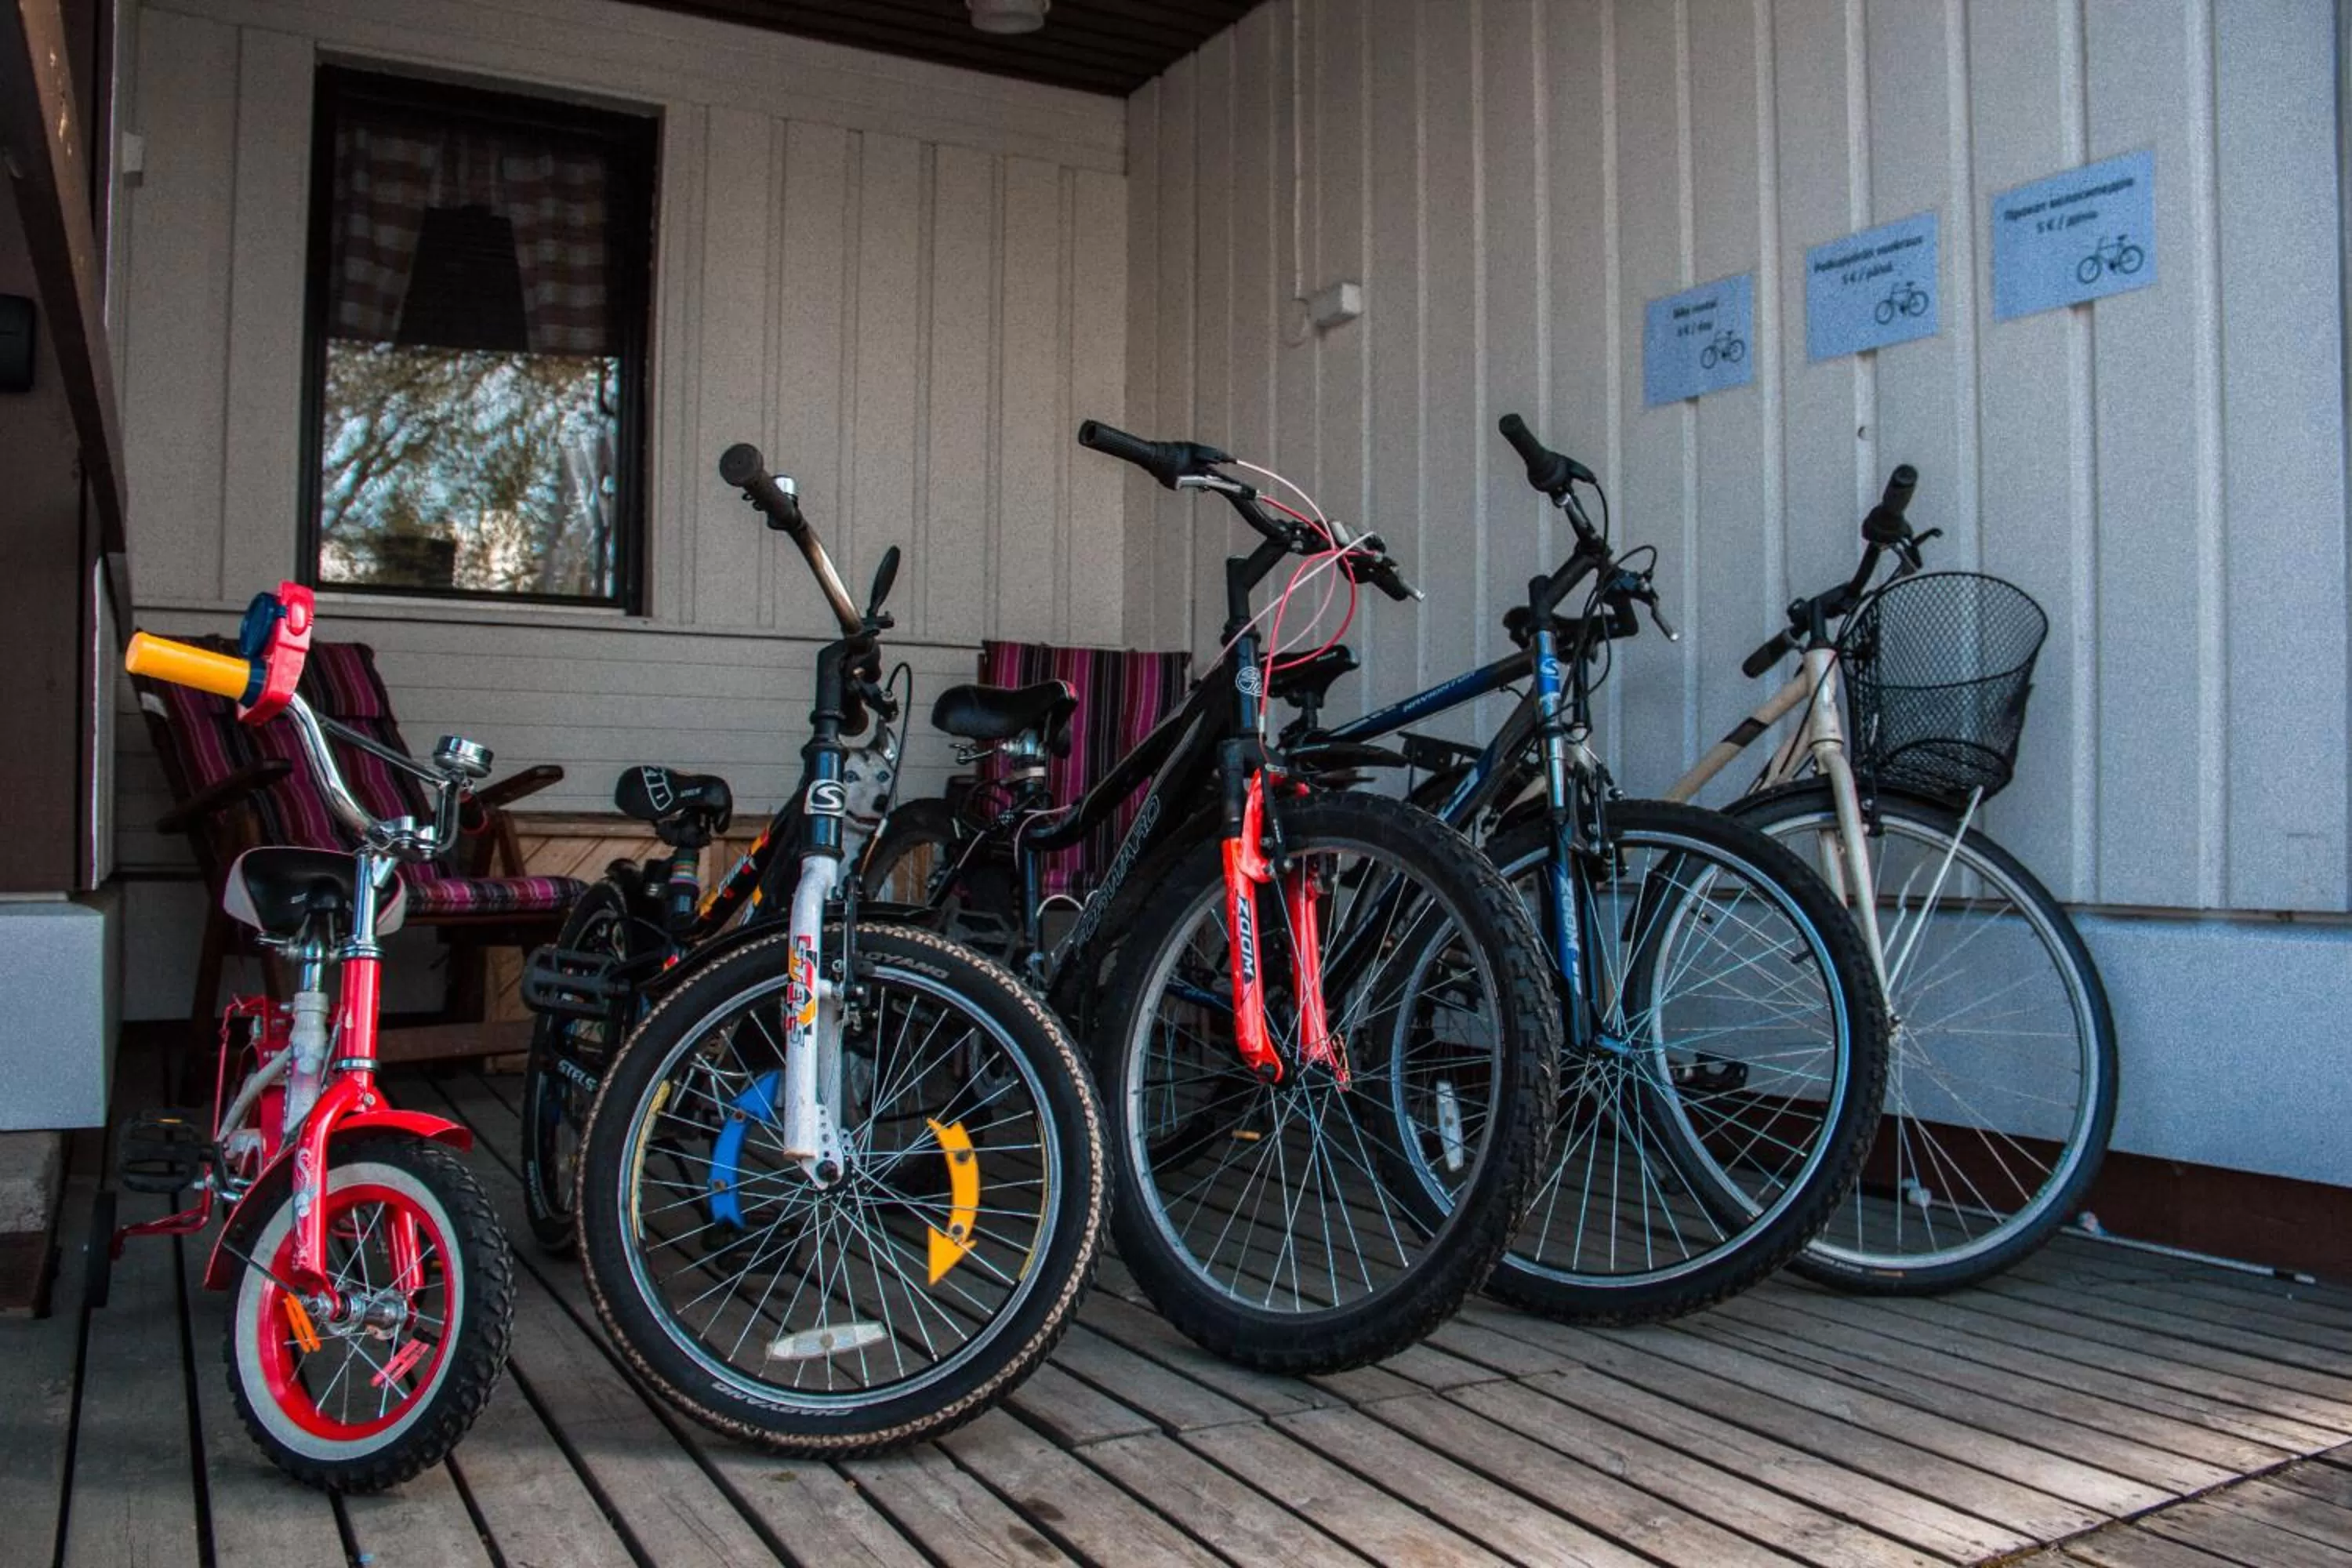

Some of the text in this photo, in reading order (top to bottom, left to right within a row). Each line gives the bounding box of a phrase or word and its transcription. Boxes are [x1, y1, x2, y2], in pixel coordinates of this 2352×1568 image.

[856, 951, 949, 979] OYANG
[1238, 896, 1254, 978] ZOOM
[785, 935, 812, 1047] STELS
[557, 1059, 597, 1091] STELS
